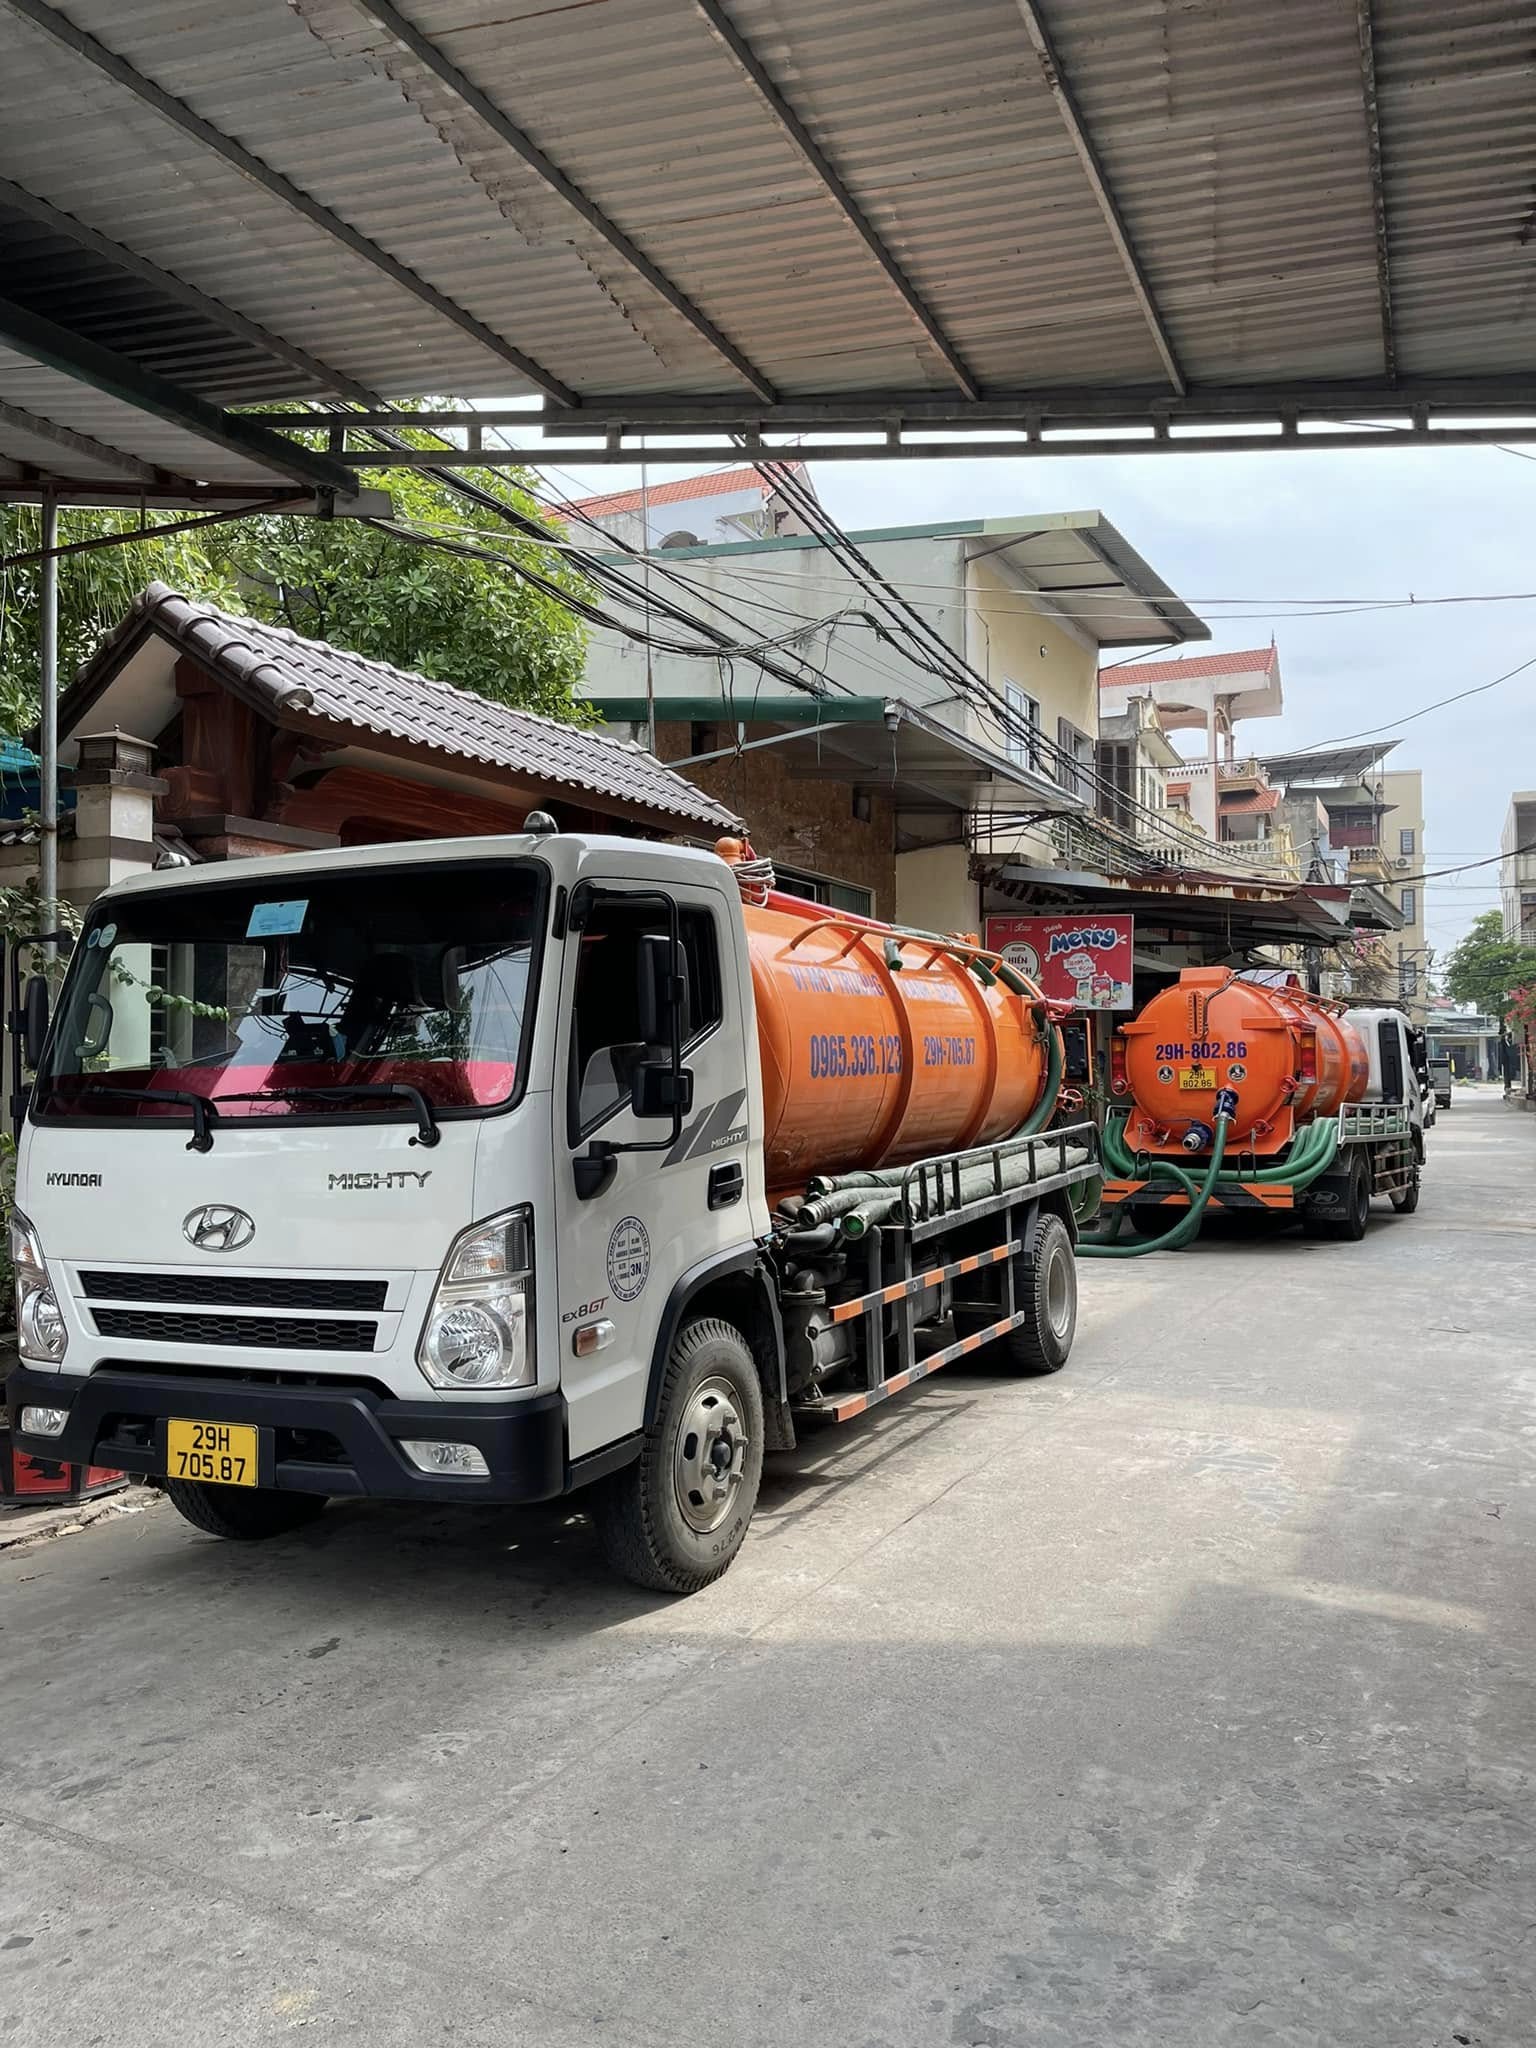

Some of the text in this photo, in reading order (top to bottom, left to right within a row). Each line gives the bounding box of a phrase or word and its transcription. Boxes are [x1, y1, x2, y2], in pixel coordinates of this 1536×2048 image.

[1051, 928, 1117, 954] Merry
[810, 1034, 903, 1079] 0965.336.123
[924, 1036, 976, 1066] 29H-705.87
[1155, 1042, 1247, 1061] 29H-802.86
[1188, 1071, 1205, 1080] 29H
[710, 1130, 745, 1148] MIGHTY
[46, 1172, 102, 1187] HYUNDAI
[328, 1171, 432, 1190] MIGHTY
[192, 1425, 230, 1452] 29H
[176, 1451, 246, 1482] 705.87
